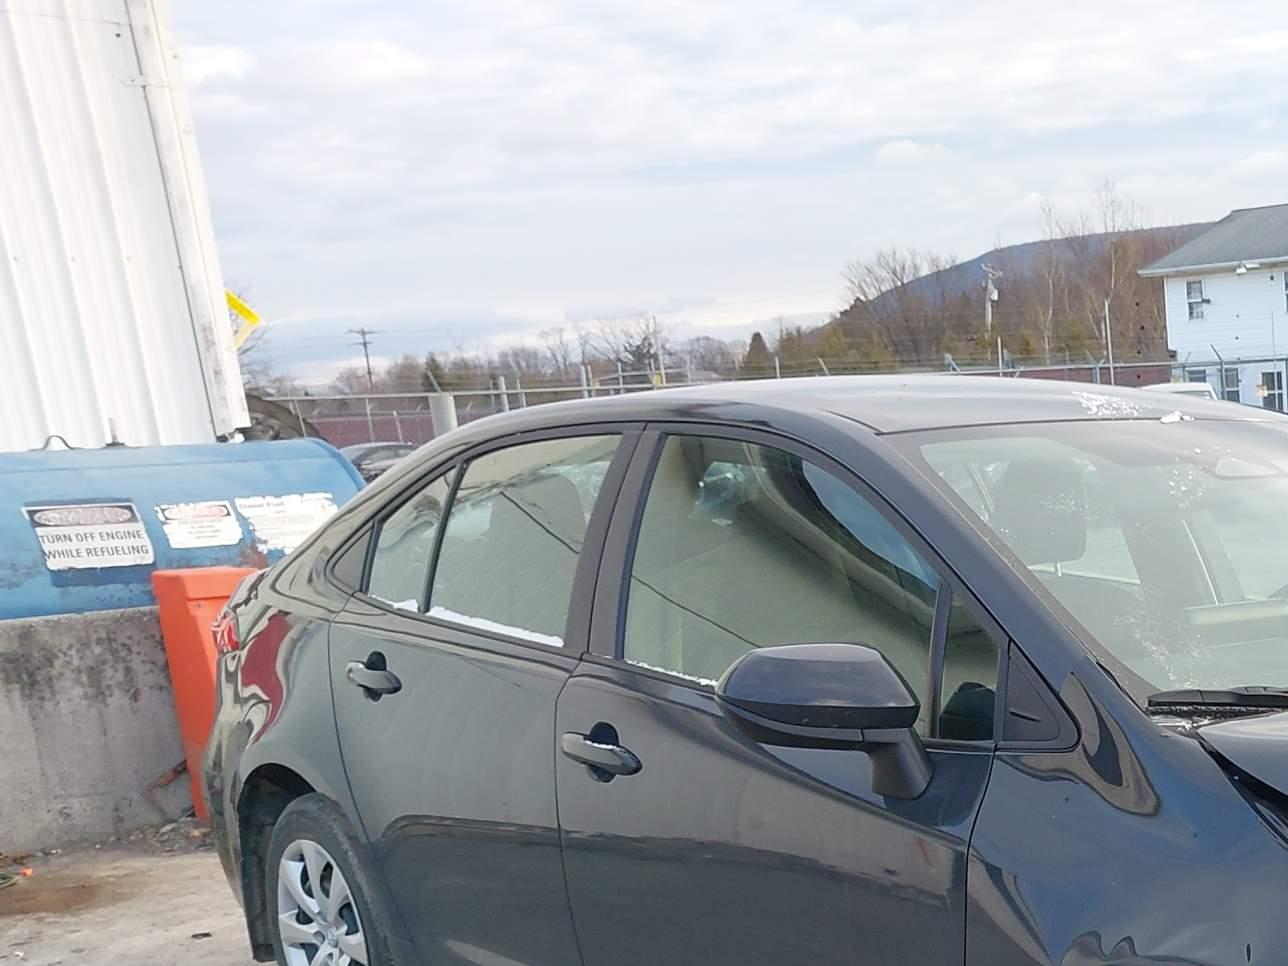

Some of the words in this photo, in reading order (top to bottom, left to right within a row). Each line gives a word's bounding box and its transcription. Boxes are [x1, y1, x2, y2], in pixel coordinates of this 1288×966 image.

[41, 533, 73, 545] TURN
[75, 532, 97, 543] OFF
[100, 530, 145, 542] ENGINE
[45, 548, 86, 560] WHILE
[86, 545, 149, 558] REFUELING
